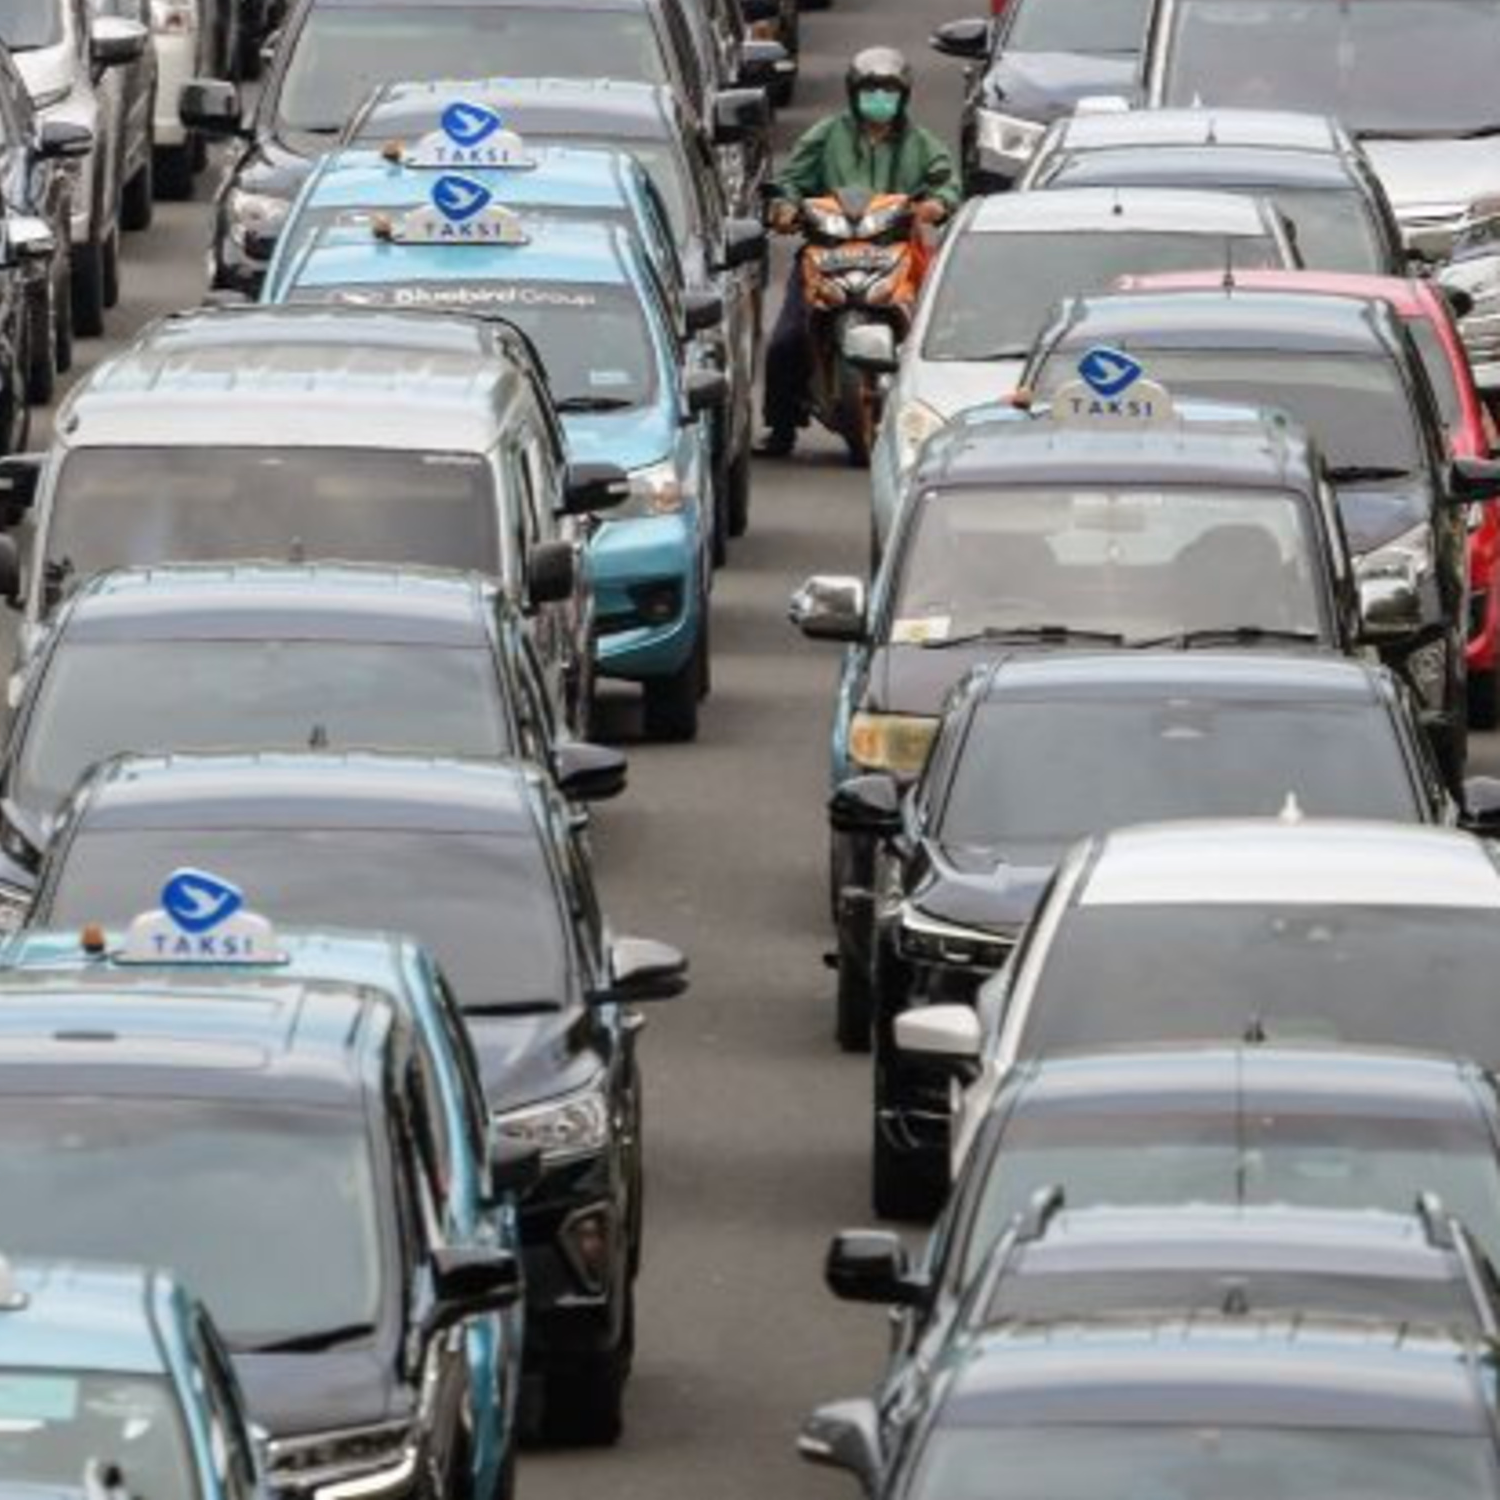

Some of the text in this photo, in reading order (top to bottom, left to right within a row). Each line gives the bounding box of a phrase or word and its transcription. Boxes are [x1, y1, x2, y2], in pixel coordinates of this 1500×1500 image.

[436, 148, 508, 162] TAKSI
[424, 222, 501, 236] TAKSI
[394, 288, 595, 306] Bluebird Group
[1070, 399, 1153, 417] TAKSI
[154, 935, 253, 955] TAKSI
